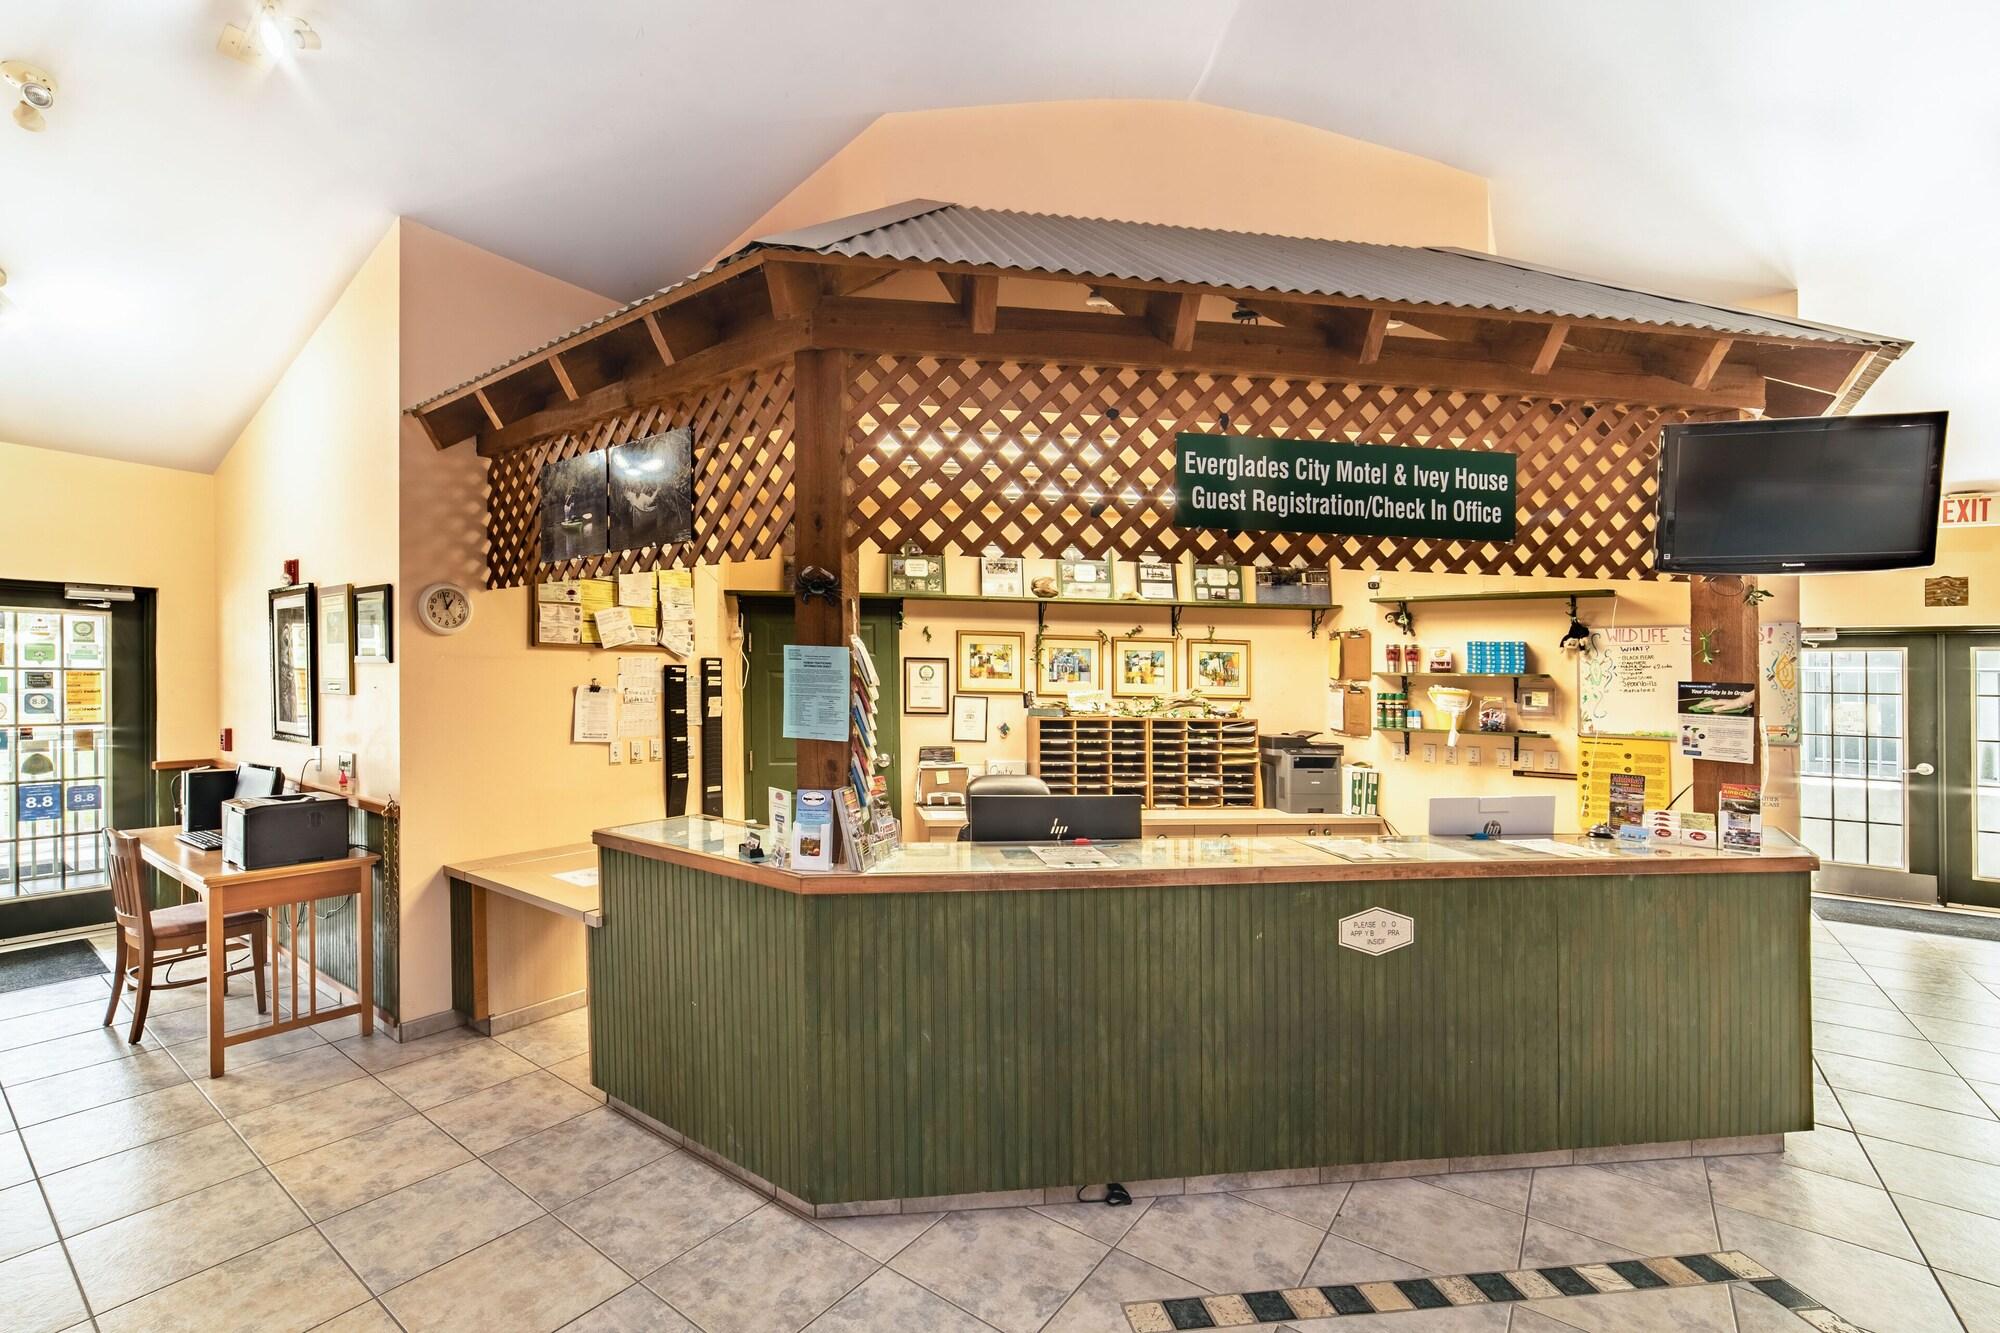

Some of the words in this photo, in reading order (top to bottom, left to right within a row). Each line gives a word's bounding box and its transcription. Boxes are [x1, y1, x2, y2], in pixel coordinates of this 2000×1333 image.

[1185, 451, 1289, 481] Everglades
[1295, 457, 1330, 487] City
[1336, 460, 1387, 485] Motel
[1394, 463, 1407, 486] &
[1413, 465, 1450, 493] Ivey
[1455, 467, 1509, 492] House
[1192, 485, 1246, 511] Guest
[1252, 489, 1426, 520] Registration/Check
[1431, 499, 1447, 521] In
[1453, 499, 1502, 524] Office
[1942, 497, 1992, 523] EXIT
[1606, 628, 1670, 643] WILDLIFE
[1050, 817, 1069, 840] hp
